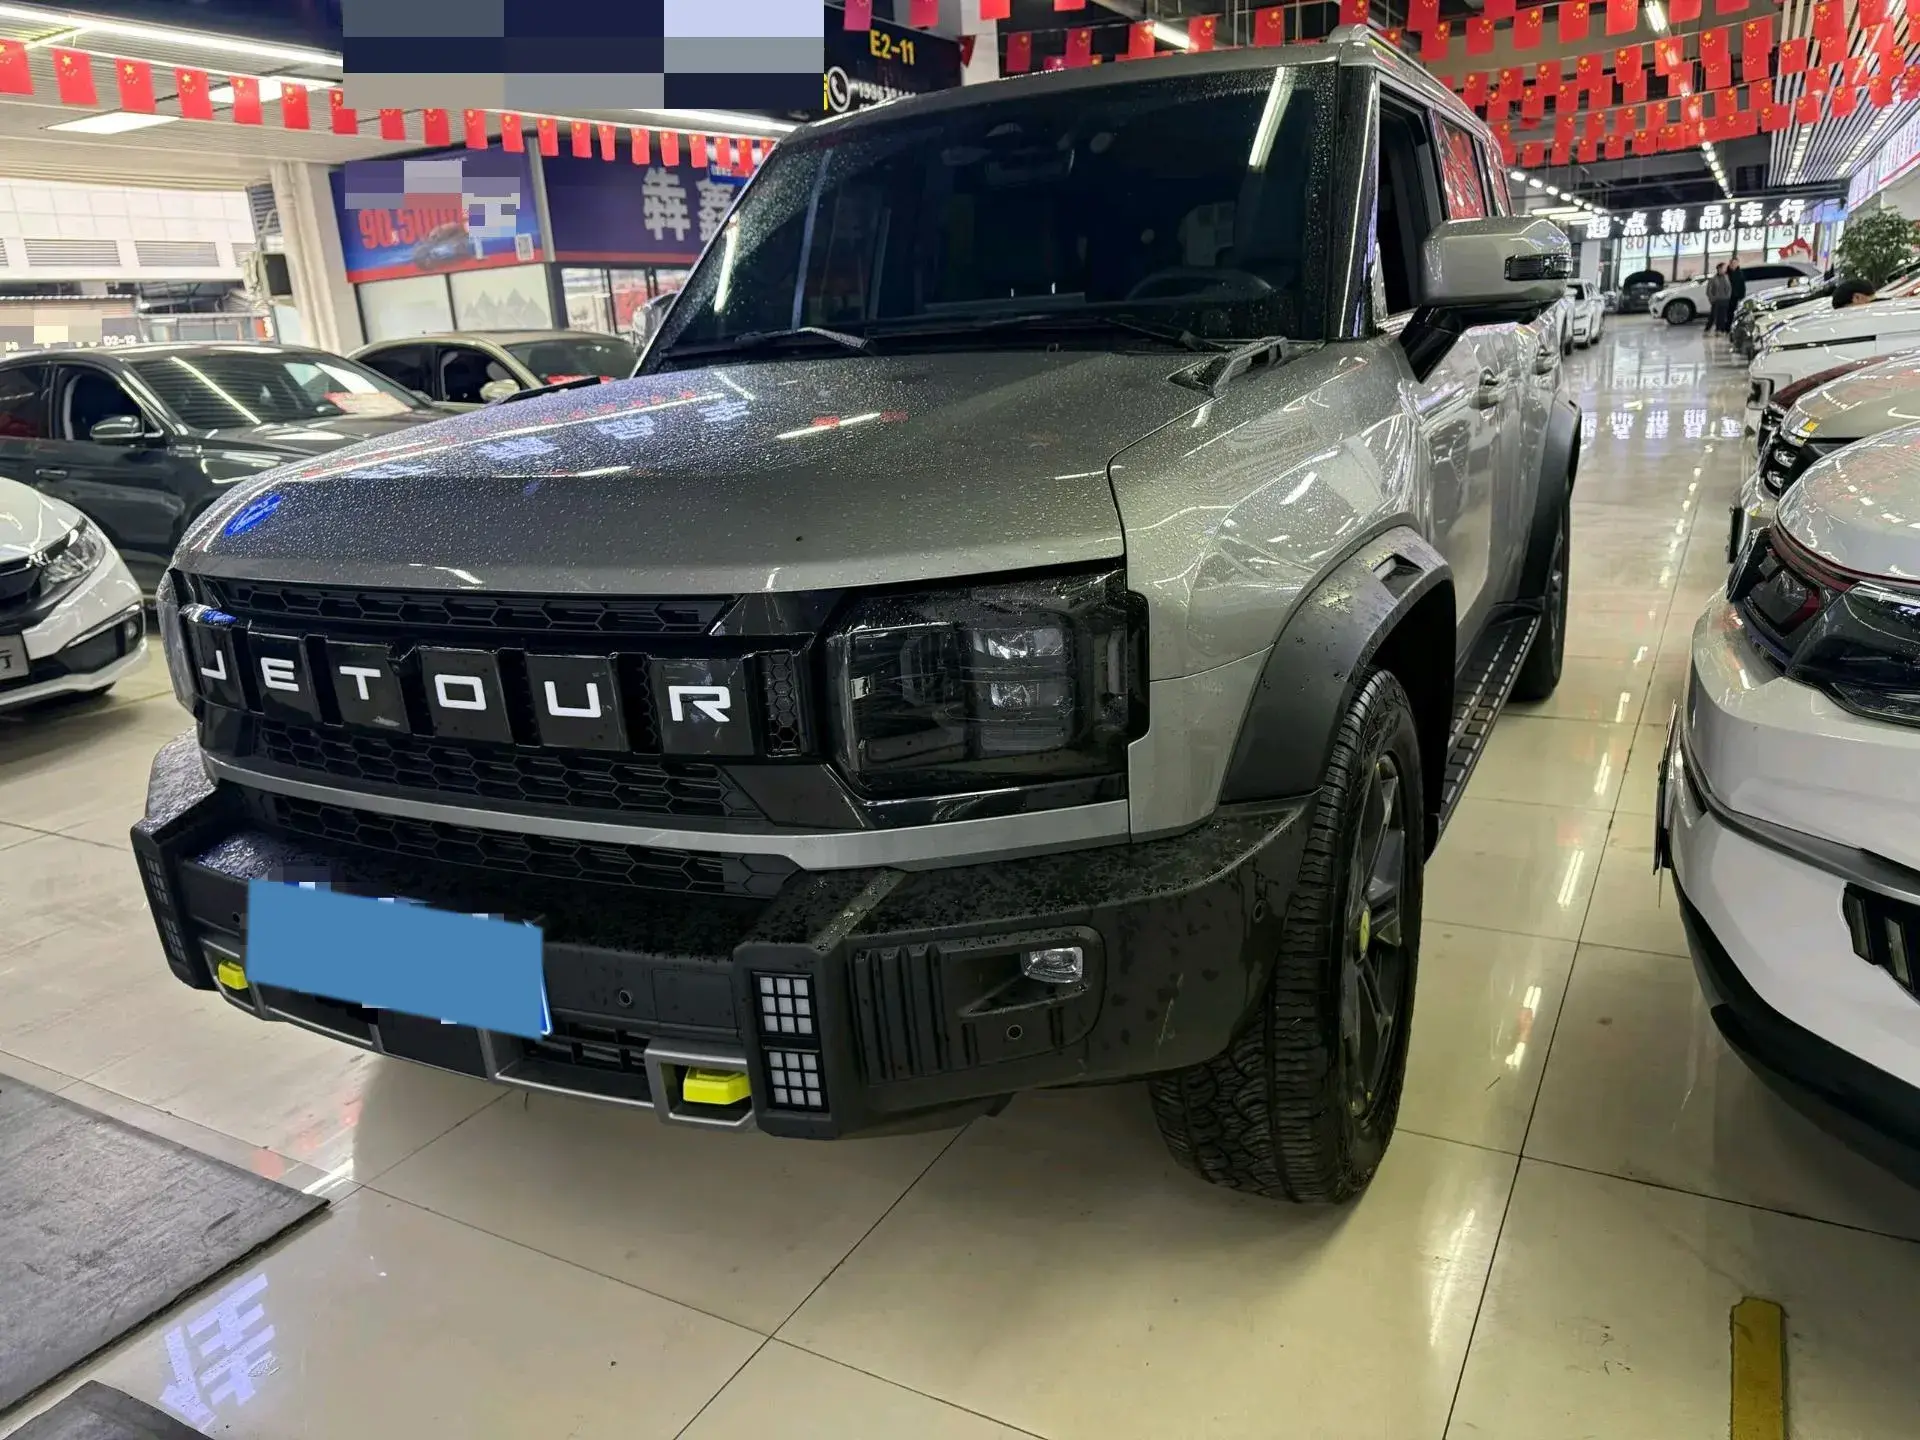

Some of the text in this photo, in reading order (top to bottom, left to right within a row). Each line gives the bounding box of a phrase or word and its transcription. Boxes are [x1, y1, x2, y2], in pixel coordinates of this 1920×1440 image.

[869, 29, 915, 65] E2-11
[1585, 199, 1806, 239] 起点精品车行
[201, 650, 731, 722] JETOUR
